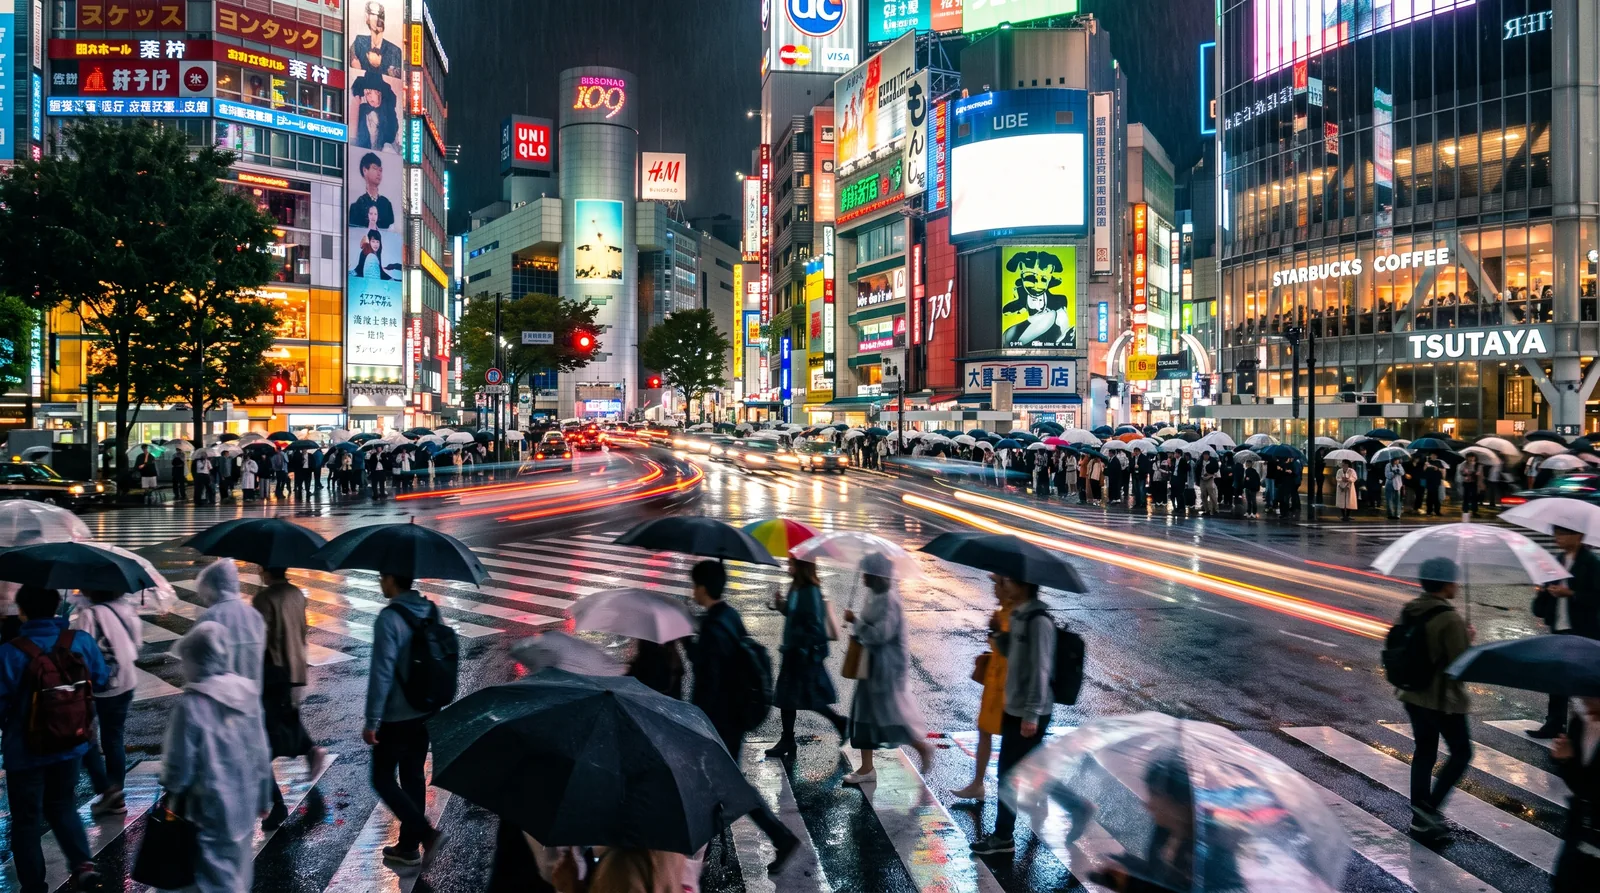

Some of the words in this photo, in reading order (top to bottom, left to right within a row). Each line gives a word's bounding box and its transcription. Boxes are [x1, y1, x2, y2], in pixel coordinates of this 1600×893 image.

[219, 8, 320, 49] ヨンタック
[827, 52, 850, 61] VISA
[573, 85, 625, 118] 109
[993, 112, 1029, 131] UBE
[518, 127, 545, 144] UNI
[518, 142, 547, 158] QLO
[647, 160, 681, 184] H&M
[1273, 259, 1363, 287] STARBUCKS
[1373, 247, 1450, 273] COFFEE
[1409, 328, 1547, 360] TSUTAYA
